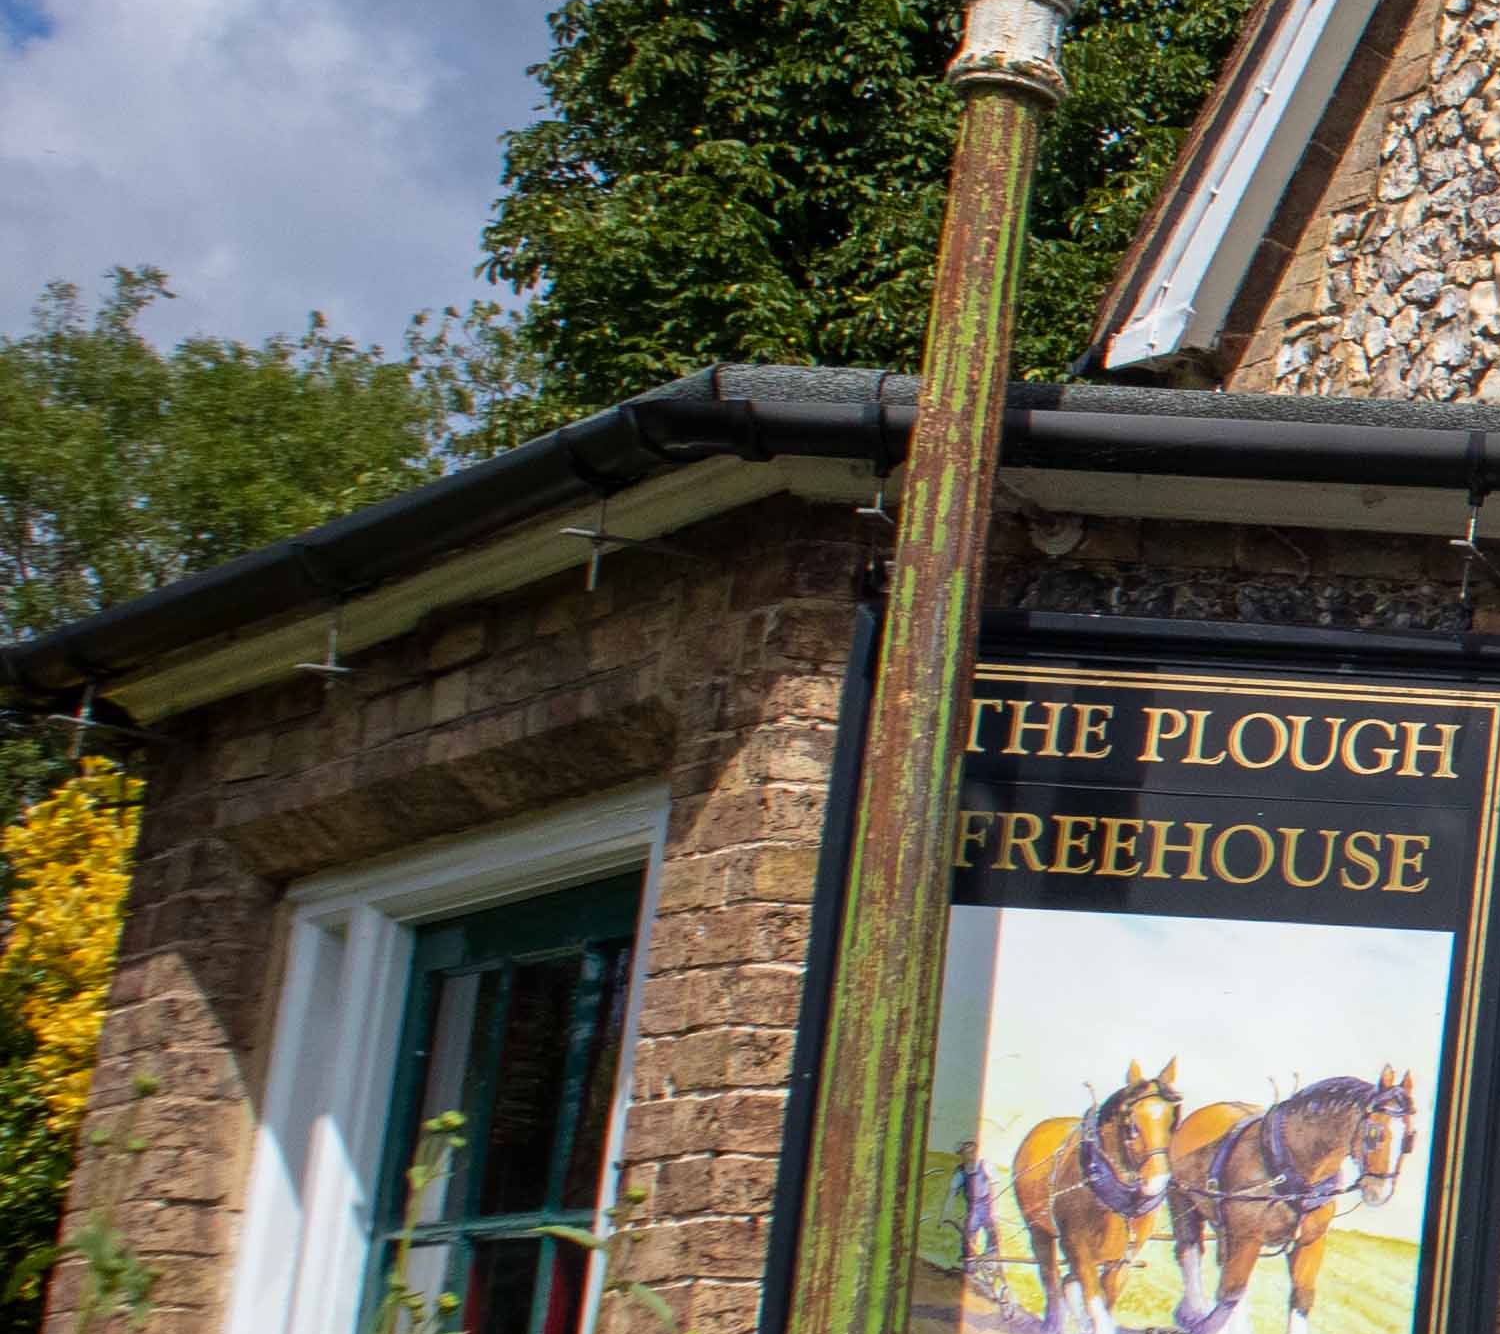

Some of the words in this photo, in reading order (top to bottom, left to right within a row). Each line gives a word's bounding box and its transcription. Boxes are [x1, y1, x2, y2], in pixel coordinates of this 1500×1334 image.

[965, 698, 1115, 759] THE
[1137, 705, 1463, 779] PLOUGH
[954, 809, 1431, 893] FREEHOUSE
